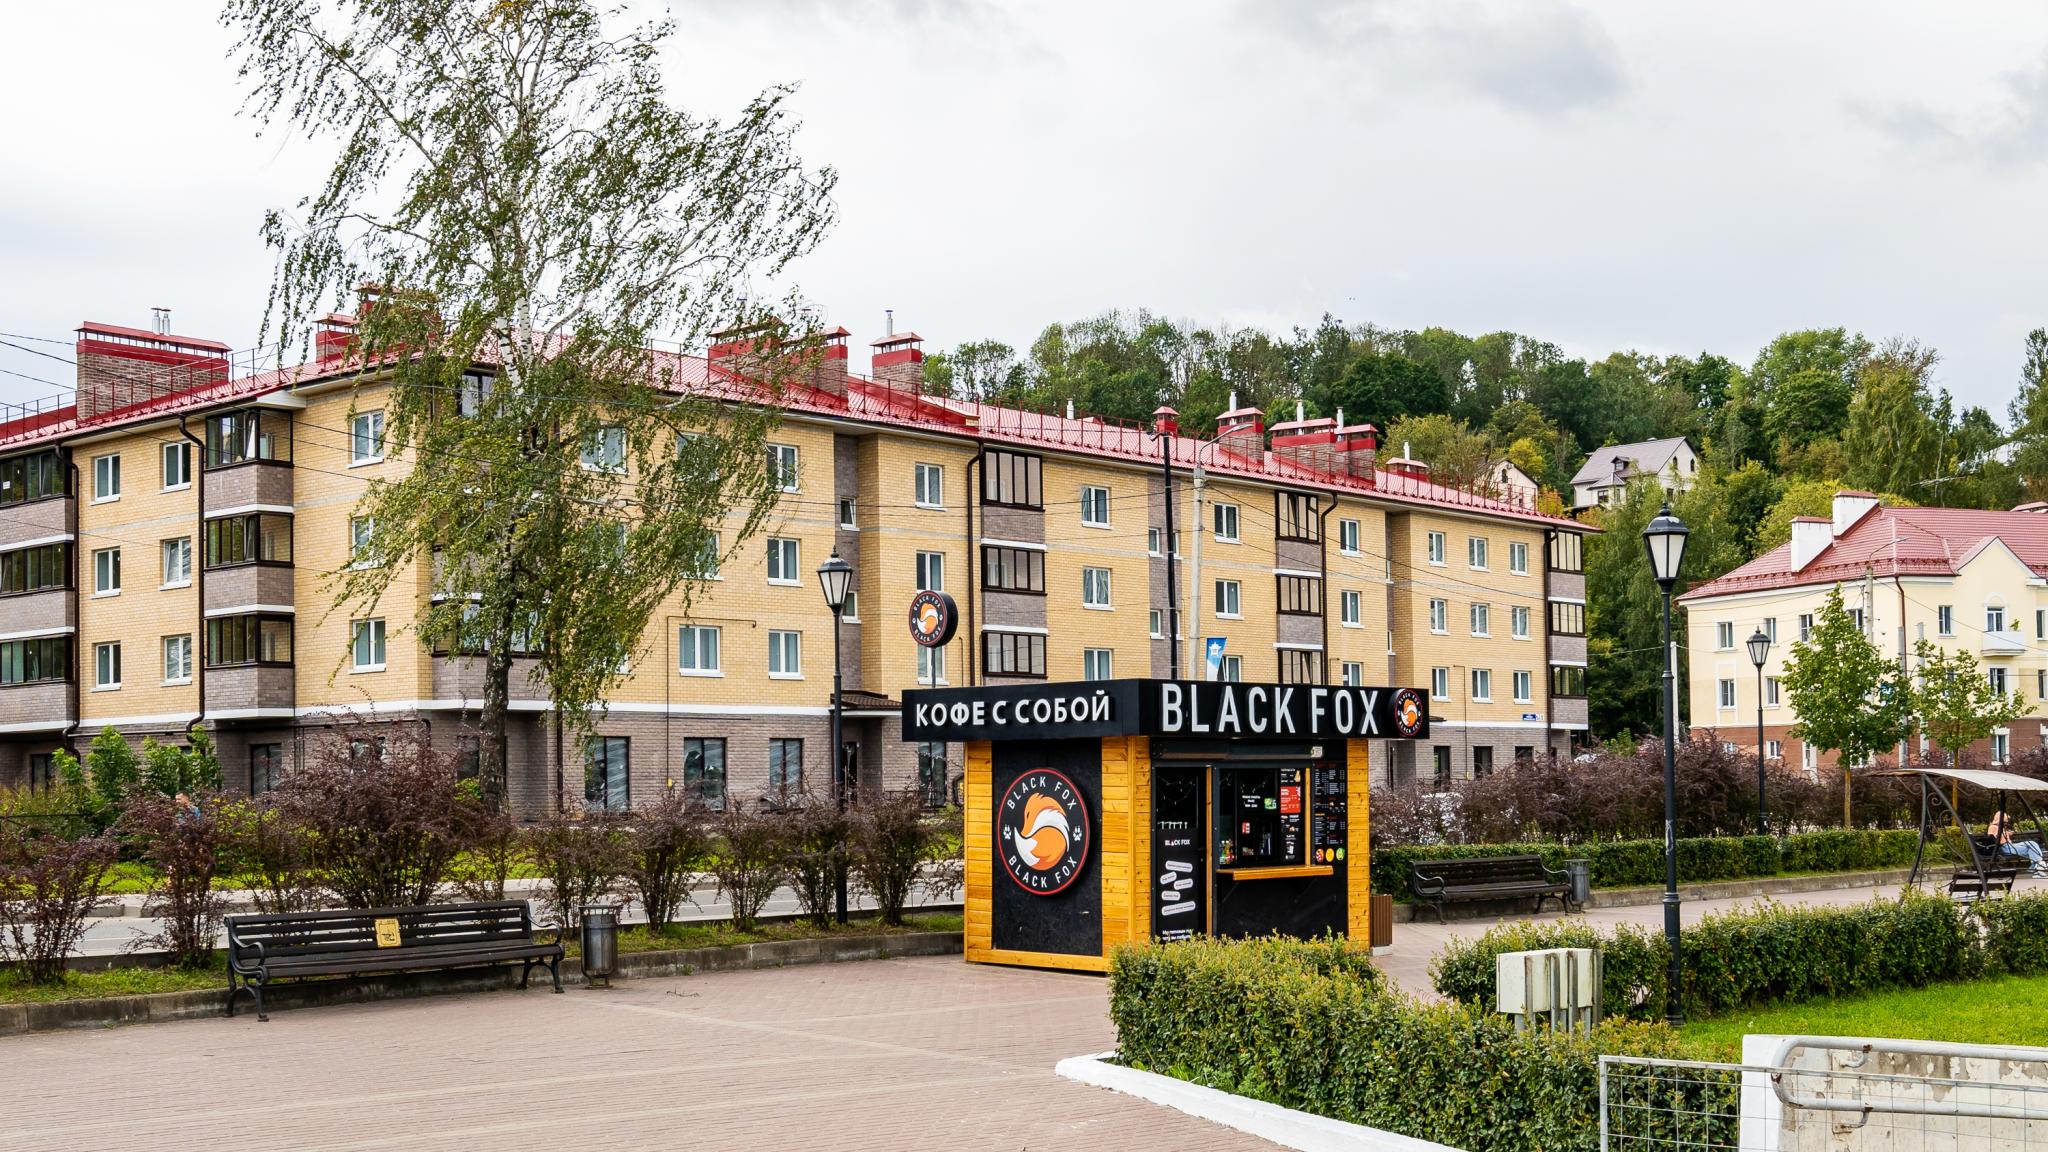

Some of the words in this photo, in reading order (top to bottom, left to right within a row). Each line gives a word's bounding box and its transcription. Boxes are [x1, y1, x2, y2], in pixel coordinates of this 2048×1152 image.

[913, 595, 929, 611] BLACK
[931, 596, 941, 608] FOX
[914, 629, 930, 642] BLACK
[932, 627, 941, 638] FOX
[916, 701, 985, 727] КОФЕ
[992, 701, 1007, 724] С
[1015, 689, 1110, 725] СОБОЙ
[1162, 683, 1296, 733] BLACK
[1311, 688, 1379, 734] FOX
[1007, 776, 1046, 810] BLACK
[1054, 781, 1077, 810] FOX
[1008, 855, 1048, 888] BLACK
[1054, 856, 1077, 884] FOX
